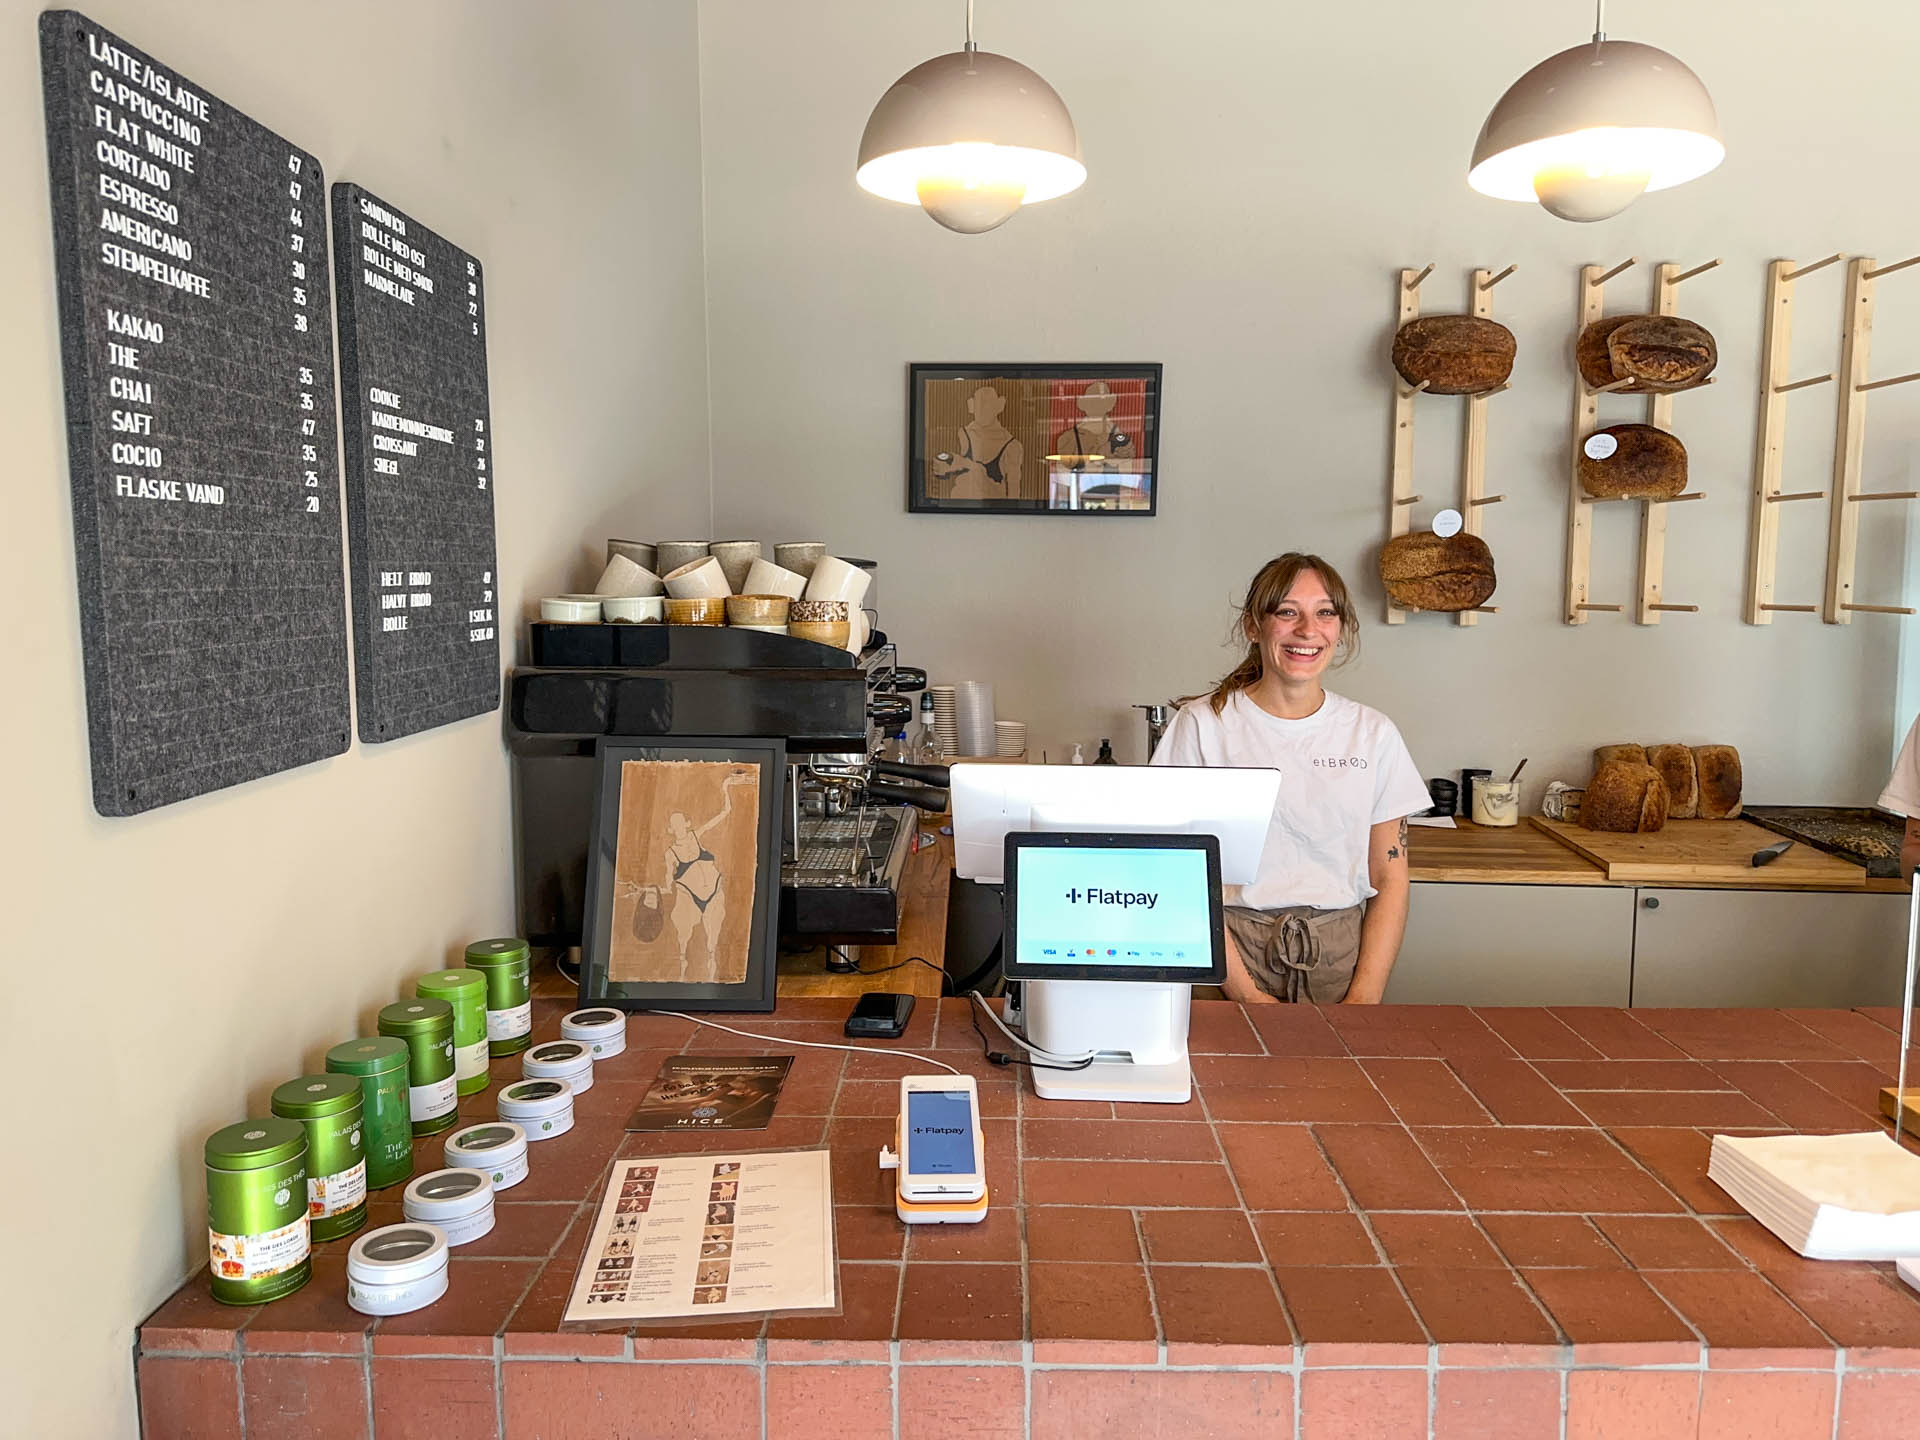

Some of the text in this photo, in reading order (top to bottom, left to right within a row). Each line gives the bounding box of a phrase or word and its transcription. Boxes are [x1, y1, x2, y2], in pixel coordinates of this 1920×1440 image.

[89, 34, 301, 175] LATTE/ISLATTE 47
[90, 70, 301, 200] CAPPUCCINO 47
[95, 105, 303, 227] FLAT WHITE 44
[97, 140, 304, 253] CORTADO 37
[100, 174, 178, 225] ESPRESSO
[360, 198, 406, 236] SANDWICH
[101, 208, 307, 306] AMERICANO 35
[362, 221, 391, 250] BOLLE
[392, 237, 410, 259] MED
[411, 249, 426, 268] OST
[364, 245, 392, 273] BOLLE
[394, 261, 412, 282] MED
[102, 242, 308, 333] STEMPELKAFFE 38
[107, 309, 313, 385] KAKAO 35
[472, 322, 478, 336] 5
[108, 342, 314, 410] THE 35
[370, 387, 401, 409] COOKIE
[110, 376, 315, 436] CHAI 47
[112, 410, 316, 462] SAFT 35
[112, 443, 318, 487] COCIO 25
[116, 475, 319, 513] FLASKE VAND 20
[381, 571, 403, 586] HELT
[382, 594, 407, 610] HALVT
[383, 616, 408, 631] BOLLE
[1087, 888, 1158, 909] Flatpay
[925, 1127, 965, 1136] Flatpay
